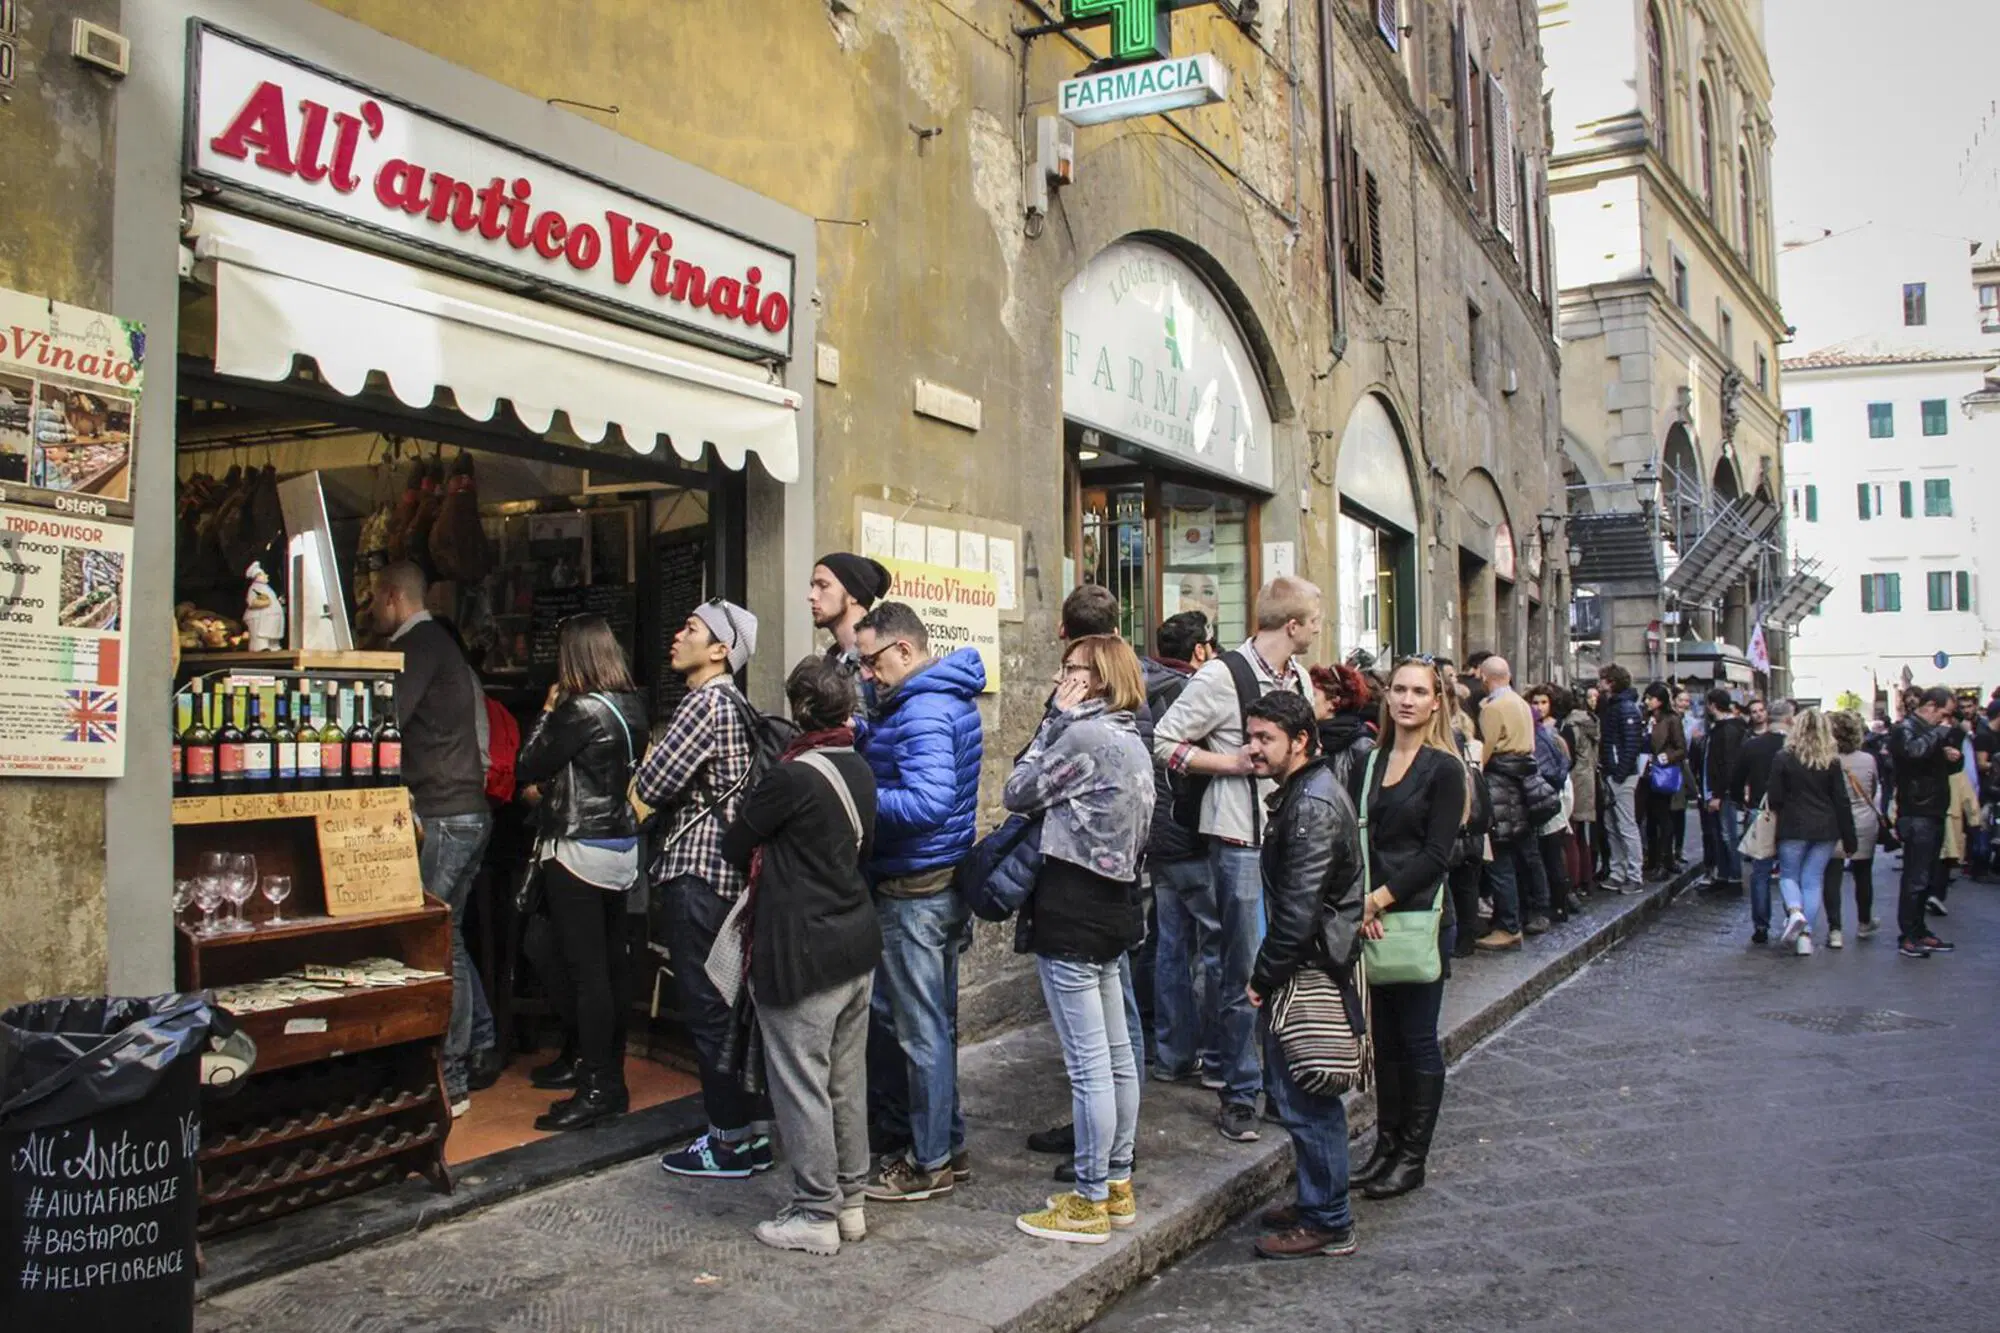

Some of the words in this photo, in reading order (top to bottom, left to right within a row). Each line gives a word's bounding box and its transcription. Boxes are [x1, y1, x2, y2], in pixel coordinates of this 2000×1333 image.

[1064, 58, 1203, 109] FARMACIA
[55, 496, 107, 517] Osteria
[5, 516, 103, 543] TRIPADVISOR
[18, 541, 59, 554] mondo
[21, 1249, 183, 1290] #HELPFLORENCE
